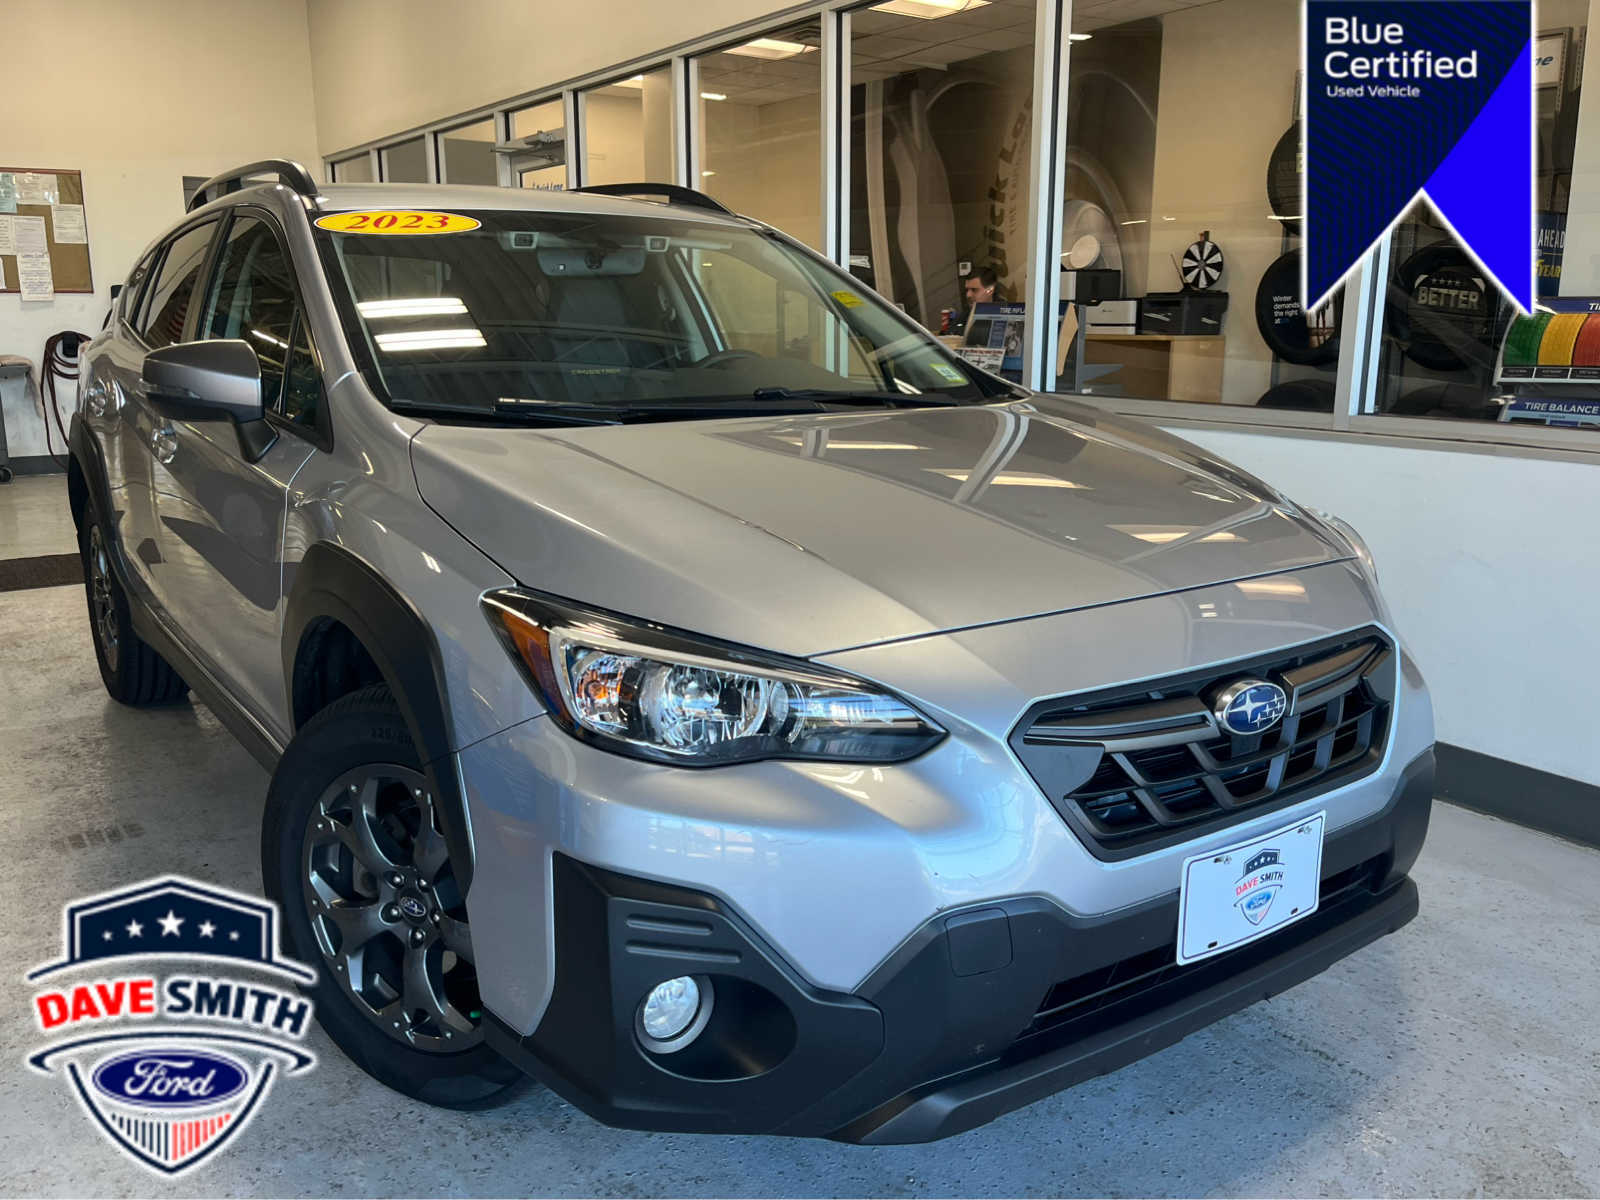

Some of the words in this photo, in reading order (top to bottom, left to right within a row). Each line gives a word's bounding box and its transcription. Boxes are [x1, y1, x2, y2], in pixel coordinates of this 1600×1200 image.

[345, 213, 450, 230] 2023
[1417, 287, 1480, 309] BETTER
[1524, 402, 1547, 411] TIRE
[1548, 402, 1599, 414] BALANCE
[1235, 876, 1259, 896] DAVE
[1259, 872, 1284, 883] SMITH
